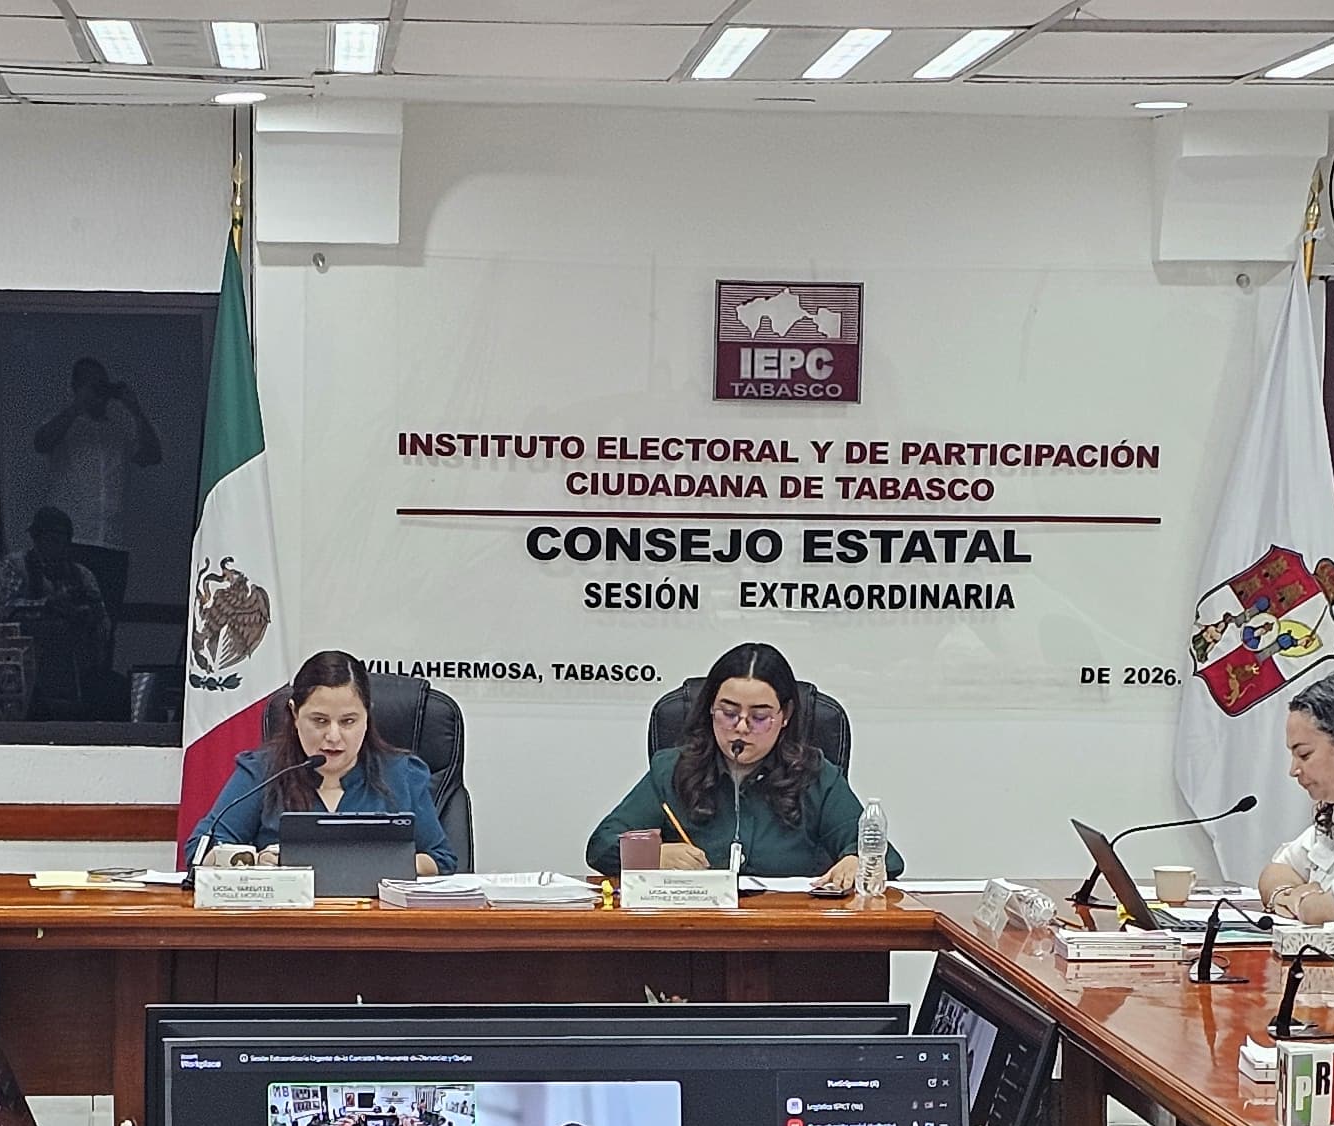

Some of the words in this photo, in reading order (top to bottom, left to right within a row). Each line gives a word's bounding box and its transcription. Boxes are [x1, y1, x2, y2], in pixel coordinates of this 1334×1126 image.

[739, 347, 835, 381] IEPC
[730, 382, 843, 398] TABASCO
[397, 432, 586, 460] INSTITUTO
[596, 436, 800, 464] ELECTORAL
[810, 440, 834, 464] Y
[845, 441, 890, 466] DE
[901, 439, 1161, 469] PARTICIPACIÓN
[565, 471, 769, 499] CIUDADANA
[779, 475, 824, 500] DE
[834, 476, 995, 502] TABASCO
[525, 525, 784, 563] CONSEJO
[801, 528, 1033, 565] ESTATAL
[583, 576, 700, 610] SESIÓN
[739, 581, 1016, 610] EXTRAORDINARIA
[551, 662, 663, 682] TABASCO.
[1080, 666, 1111, 685] DE
[1122, 666, 1183, 687] 2026.
